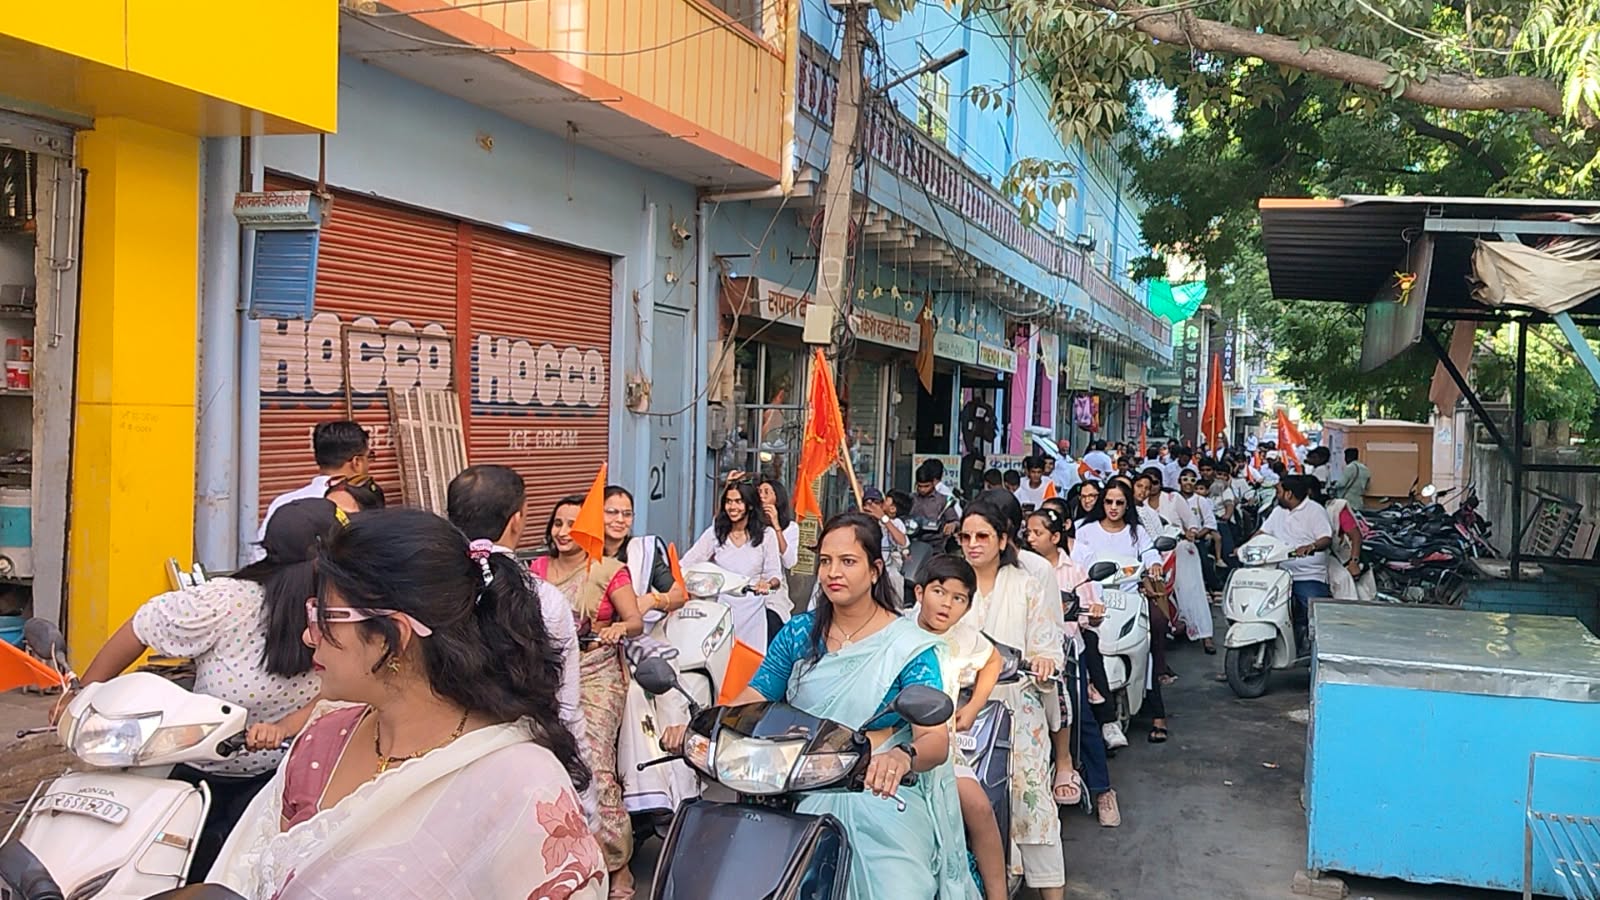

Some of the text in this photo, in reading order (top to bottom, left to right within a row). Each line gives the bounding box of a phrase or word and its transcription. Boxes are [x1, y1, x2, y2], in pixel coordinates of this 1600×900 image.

[768, 290, 798, 320] सपना
[260, 312, 452, 395] HOCCO
[477, 334, 605, 407] HOCCO
[509, 430, 578, 449] ICE CREAM
[650, 461, 666, 500] 21
[78, 787, 116, 797] HONDA
